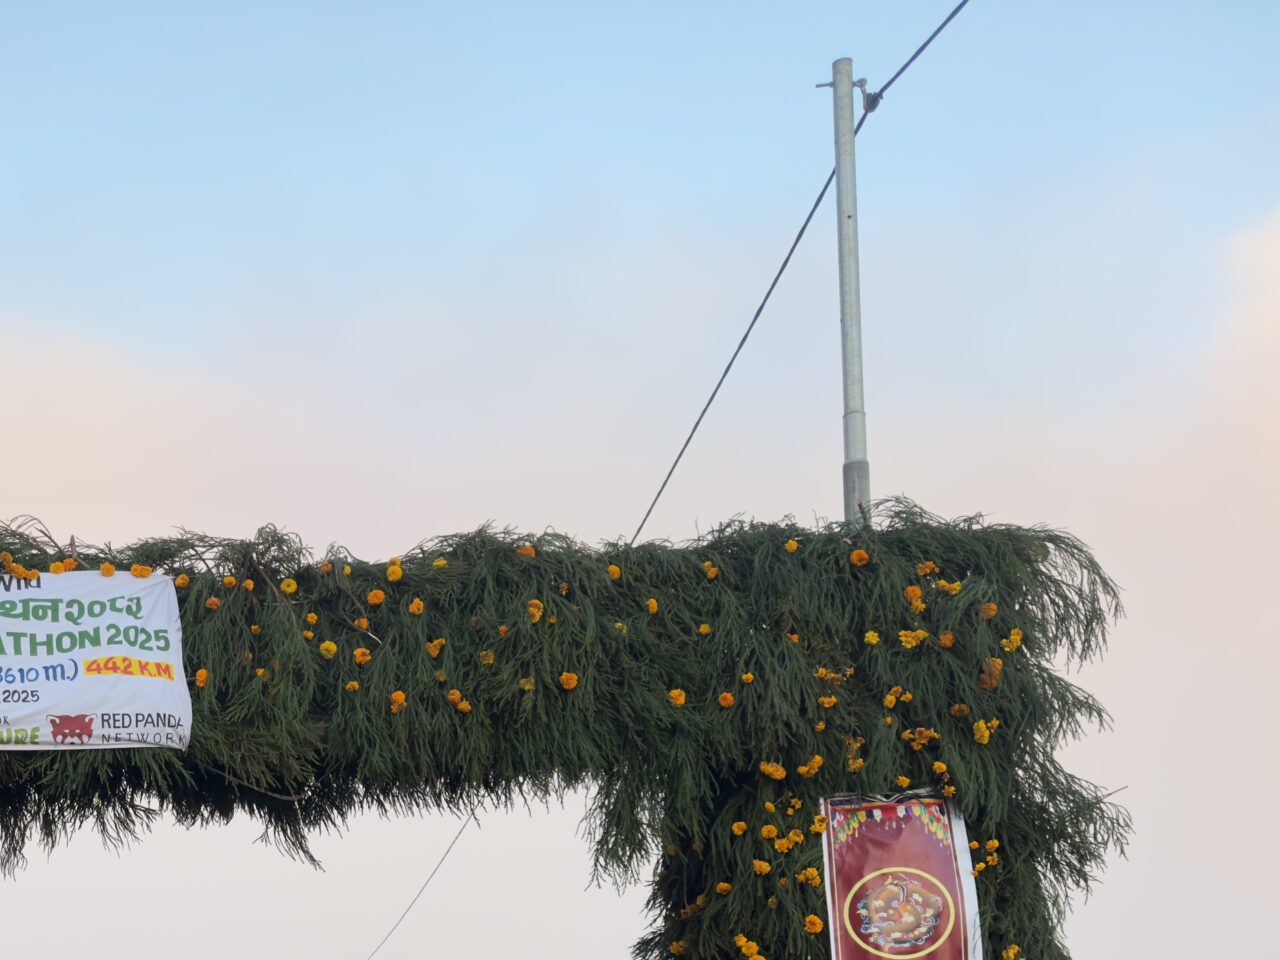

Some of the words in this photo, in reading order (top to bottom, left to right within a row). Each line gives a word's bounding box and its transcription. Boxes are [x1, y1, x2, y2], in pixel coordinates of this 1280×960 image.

[65, 595, 144, 626] २०८२
[106, 623, 171, 651] 2025
[101, 713, 132, 729] RED
[101, 732, 186, 747] NETWORK
